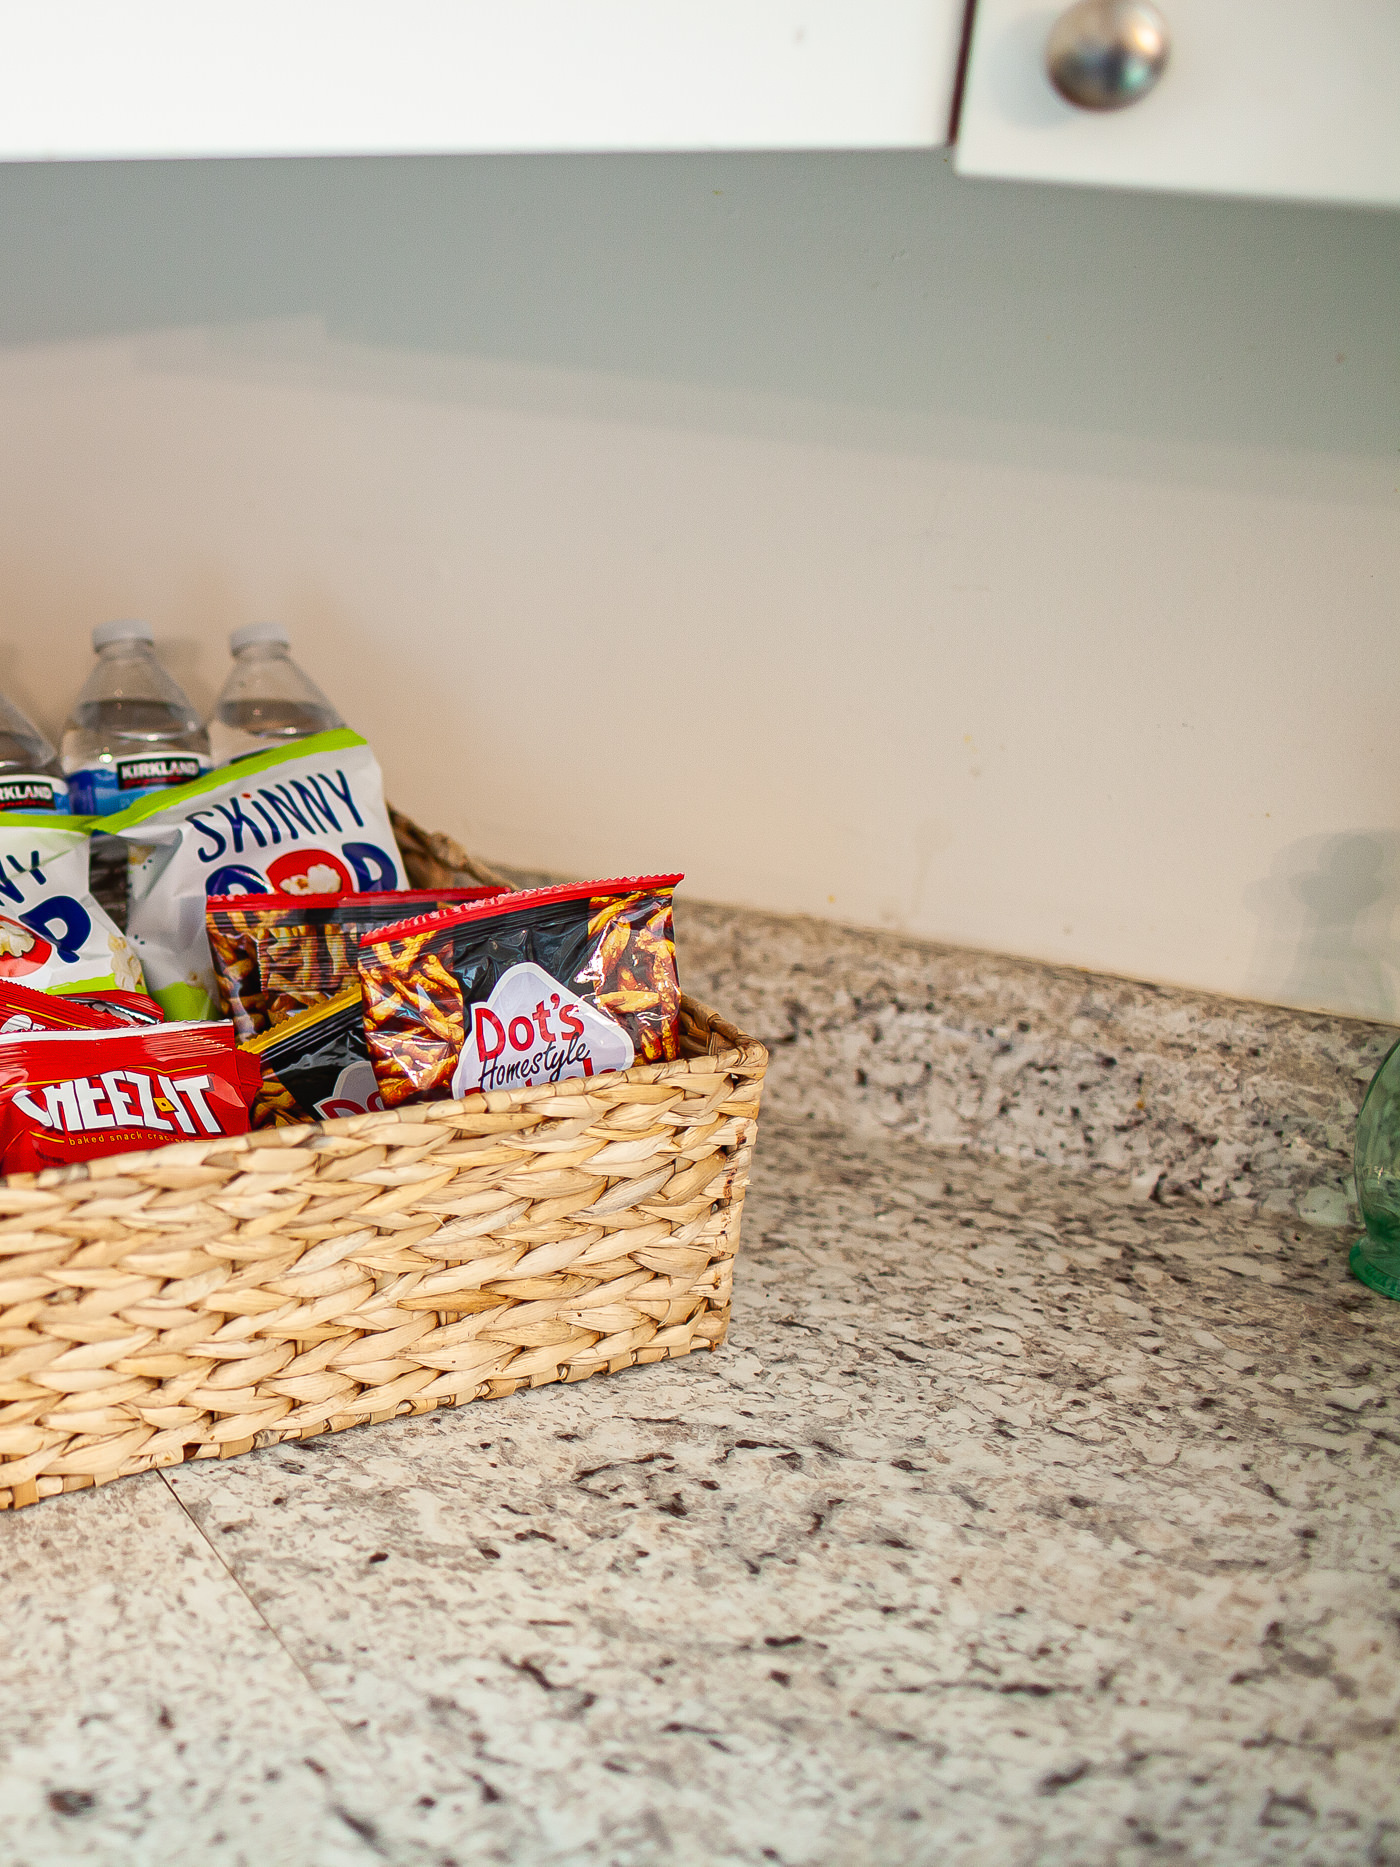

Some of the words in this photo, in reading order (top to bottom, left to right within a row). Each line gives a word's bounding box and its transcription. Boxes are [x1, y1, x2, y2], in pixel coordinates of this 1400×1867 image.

[121, 760, 199, 780] KIRKLAND
[474, 992, 586, 1063] Dot's
[477, 1031, 592, 1091] Homestyle
[68, 1134, 105, 1146] baked
[109, 1131, 143, 1143] snack
